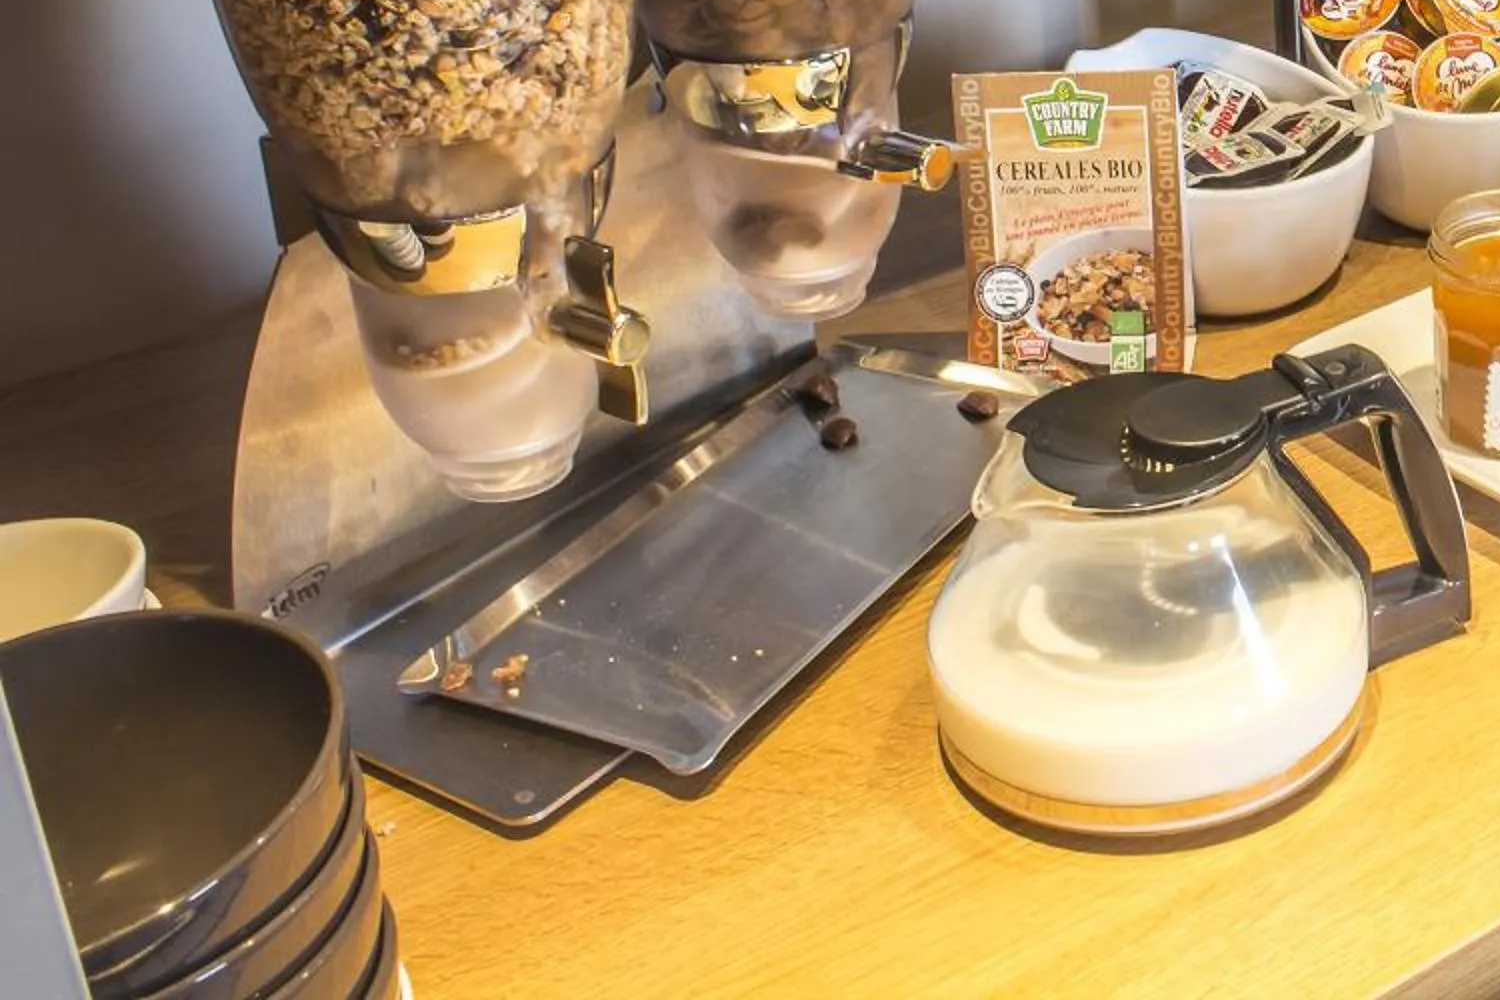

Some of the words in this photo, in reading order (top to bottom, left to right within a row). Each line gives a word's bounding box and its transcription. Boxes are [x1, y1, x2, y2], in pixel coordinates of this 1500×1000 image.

[1032, 101, 1099, 121] COUNTRY
[1208, 89, 1245, 138] nutella
[1044, 119, 1087, 137] FARM
[996, 158, 1102, 181] CEREALES
[1107, 158, 1143, 179] BIO
[1113, 351, 1139, 370] AB
